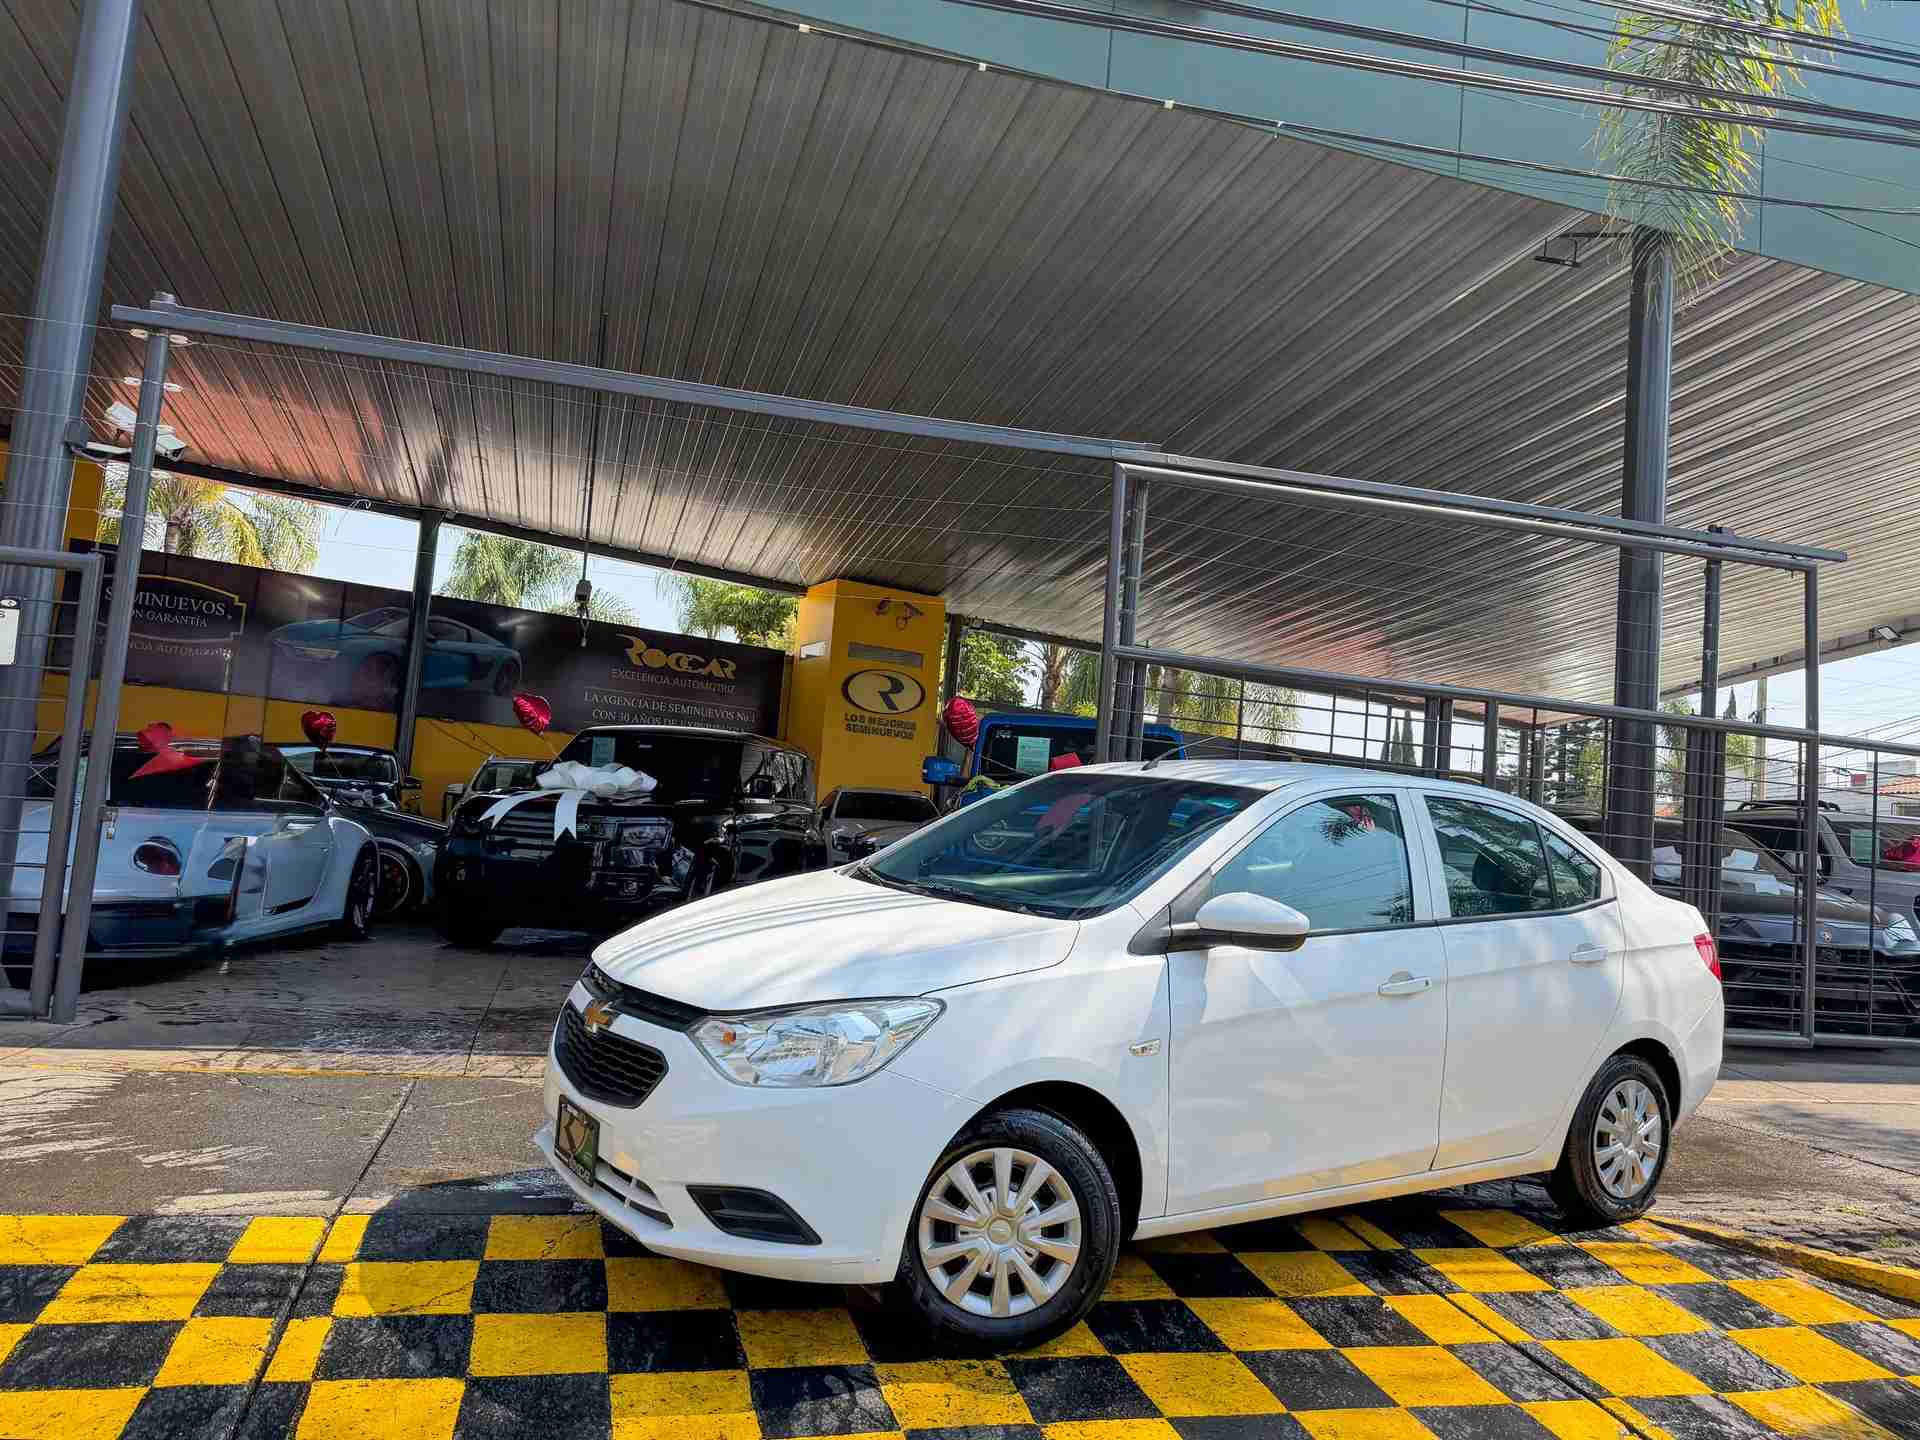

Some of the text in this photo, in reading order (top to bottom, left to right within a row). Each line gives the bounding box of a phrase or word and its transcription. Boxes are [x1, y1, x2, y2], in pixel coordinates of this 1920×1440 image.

[105, 586, 226, 616] SMINUEVOS
[146, 611, 209, 628] GARANTÍA
[616, 633, 737, 680] ROCCAR
[584, 690, 600, 705] LA
[599, 693, 650, 710] AGENCIA
[651, 700, 667, 712] DE
[667, 702, 736, 721] SEMINUEVOS
[592, 709, 617, 721] CON
[844, 712, 865, 724] LOS
[845, 723, 914, 740] SEMINUEVOS
